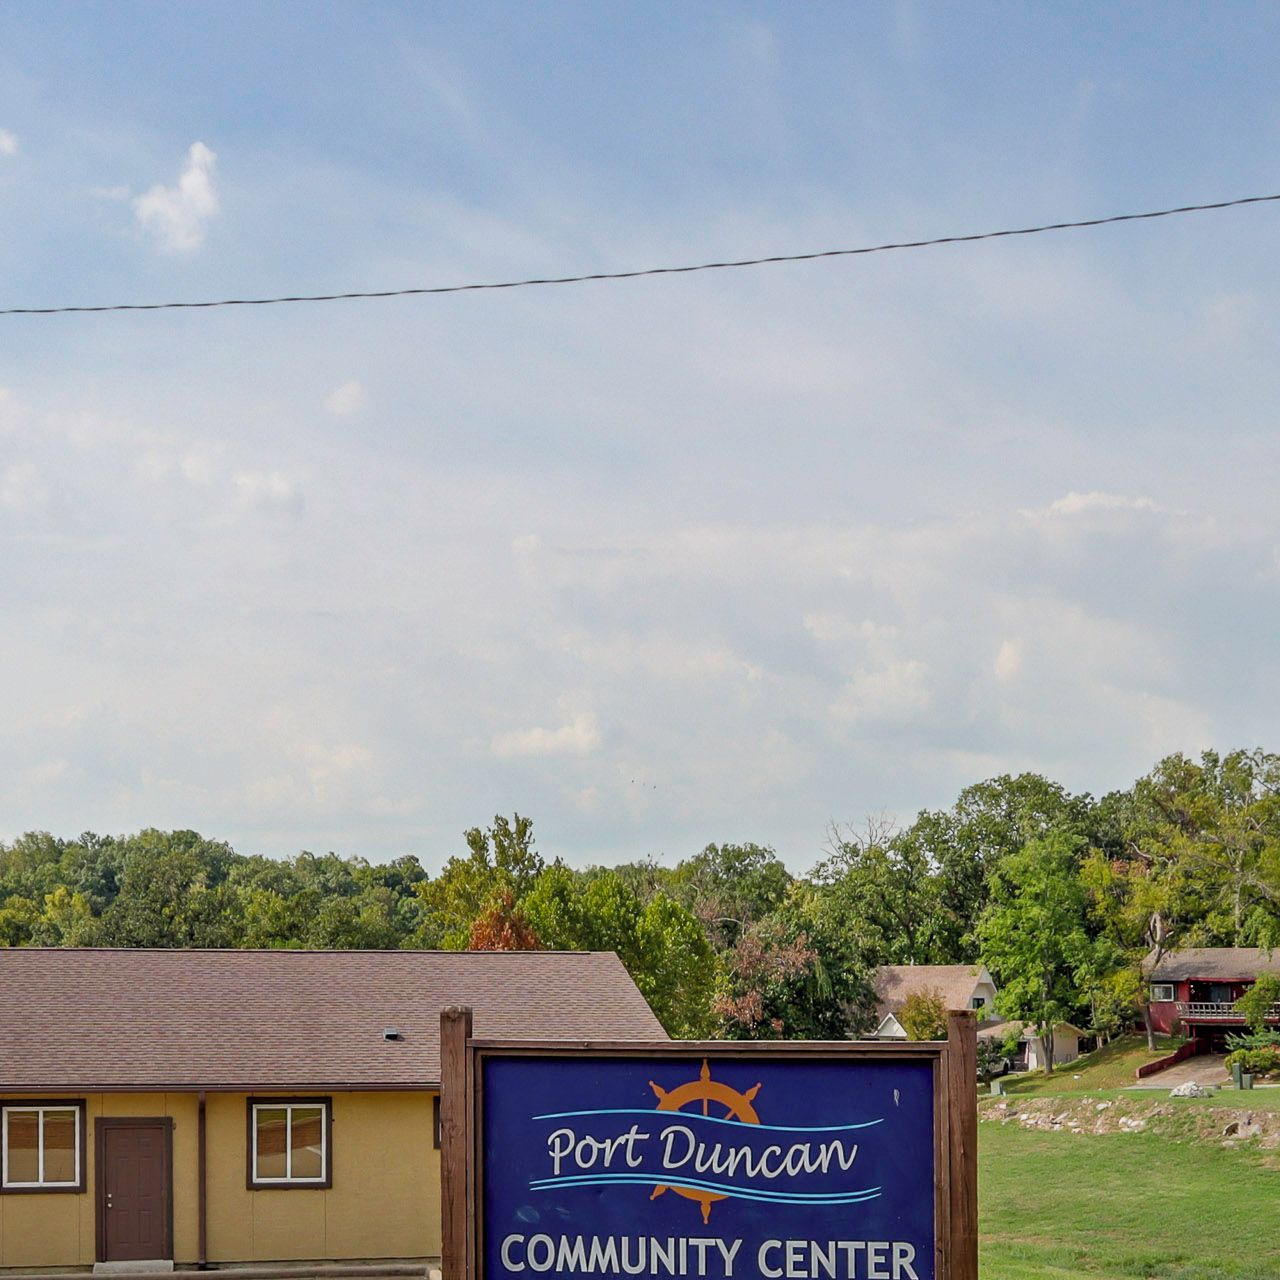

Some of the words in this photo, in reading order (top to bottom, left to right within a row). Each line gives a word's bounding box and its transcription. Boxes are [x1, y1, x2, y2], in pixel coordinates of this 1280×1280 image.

[547, 1124, 650, 1176] Port
[659, 1125, 858, 1179] Duncan
[501, 1233, 743, 1277] COMMUNITY
[757, 1239, 919, 1280] CENTER
